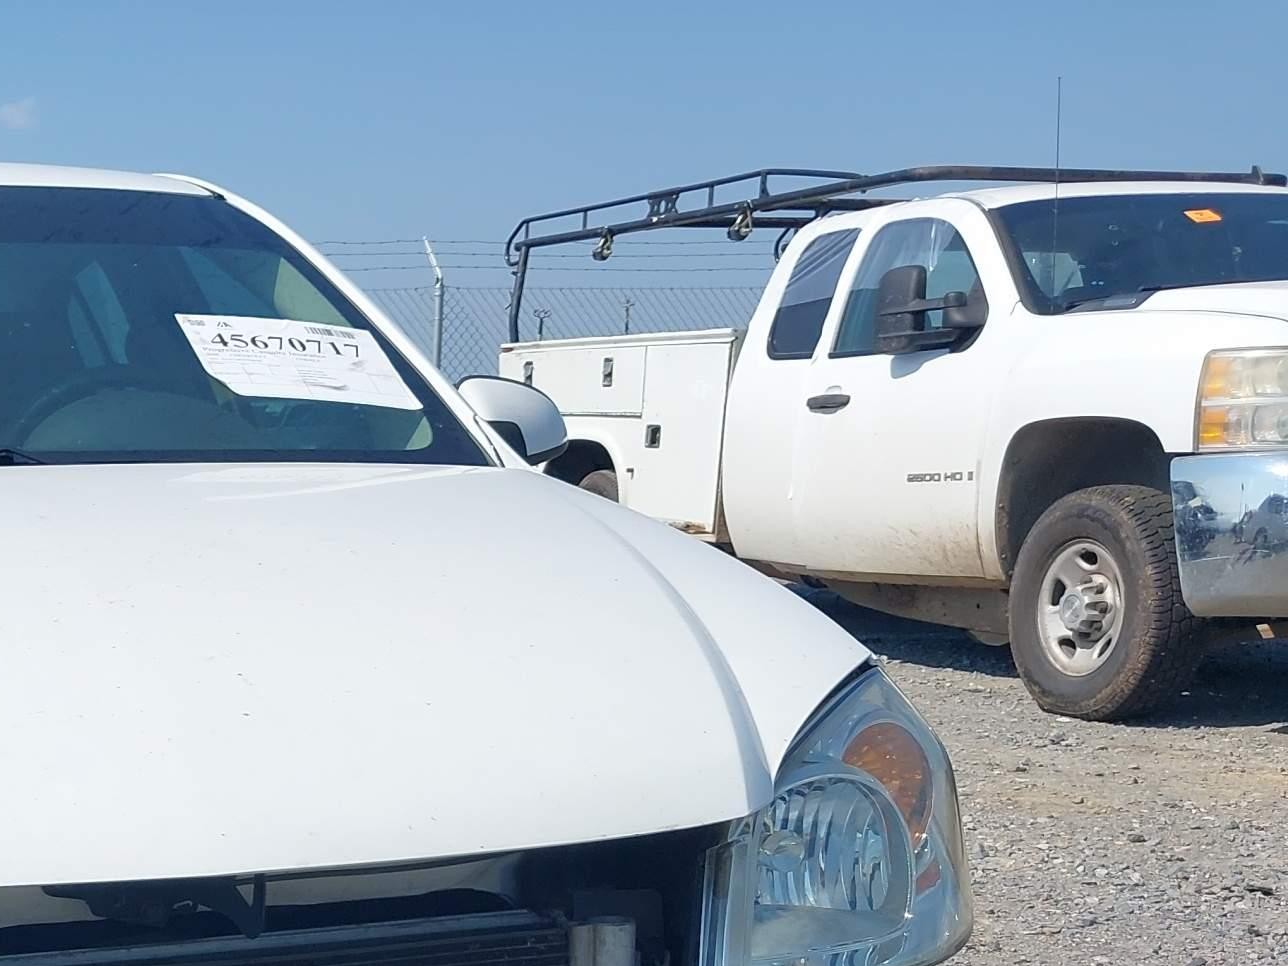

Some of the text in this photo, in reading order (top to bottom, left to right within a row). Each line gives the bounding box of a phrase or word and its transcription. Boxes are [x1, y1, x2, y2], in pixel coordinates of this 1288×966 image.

[210, 332, 360, 358] 45670717
[906, 471, 963, 482] 2500 HD
